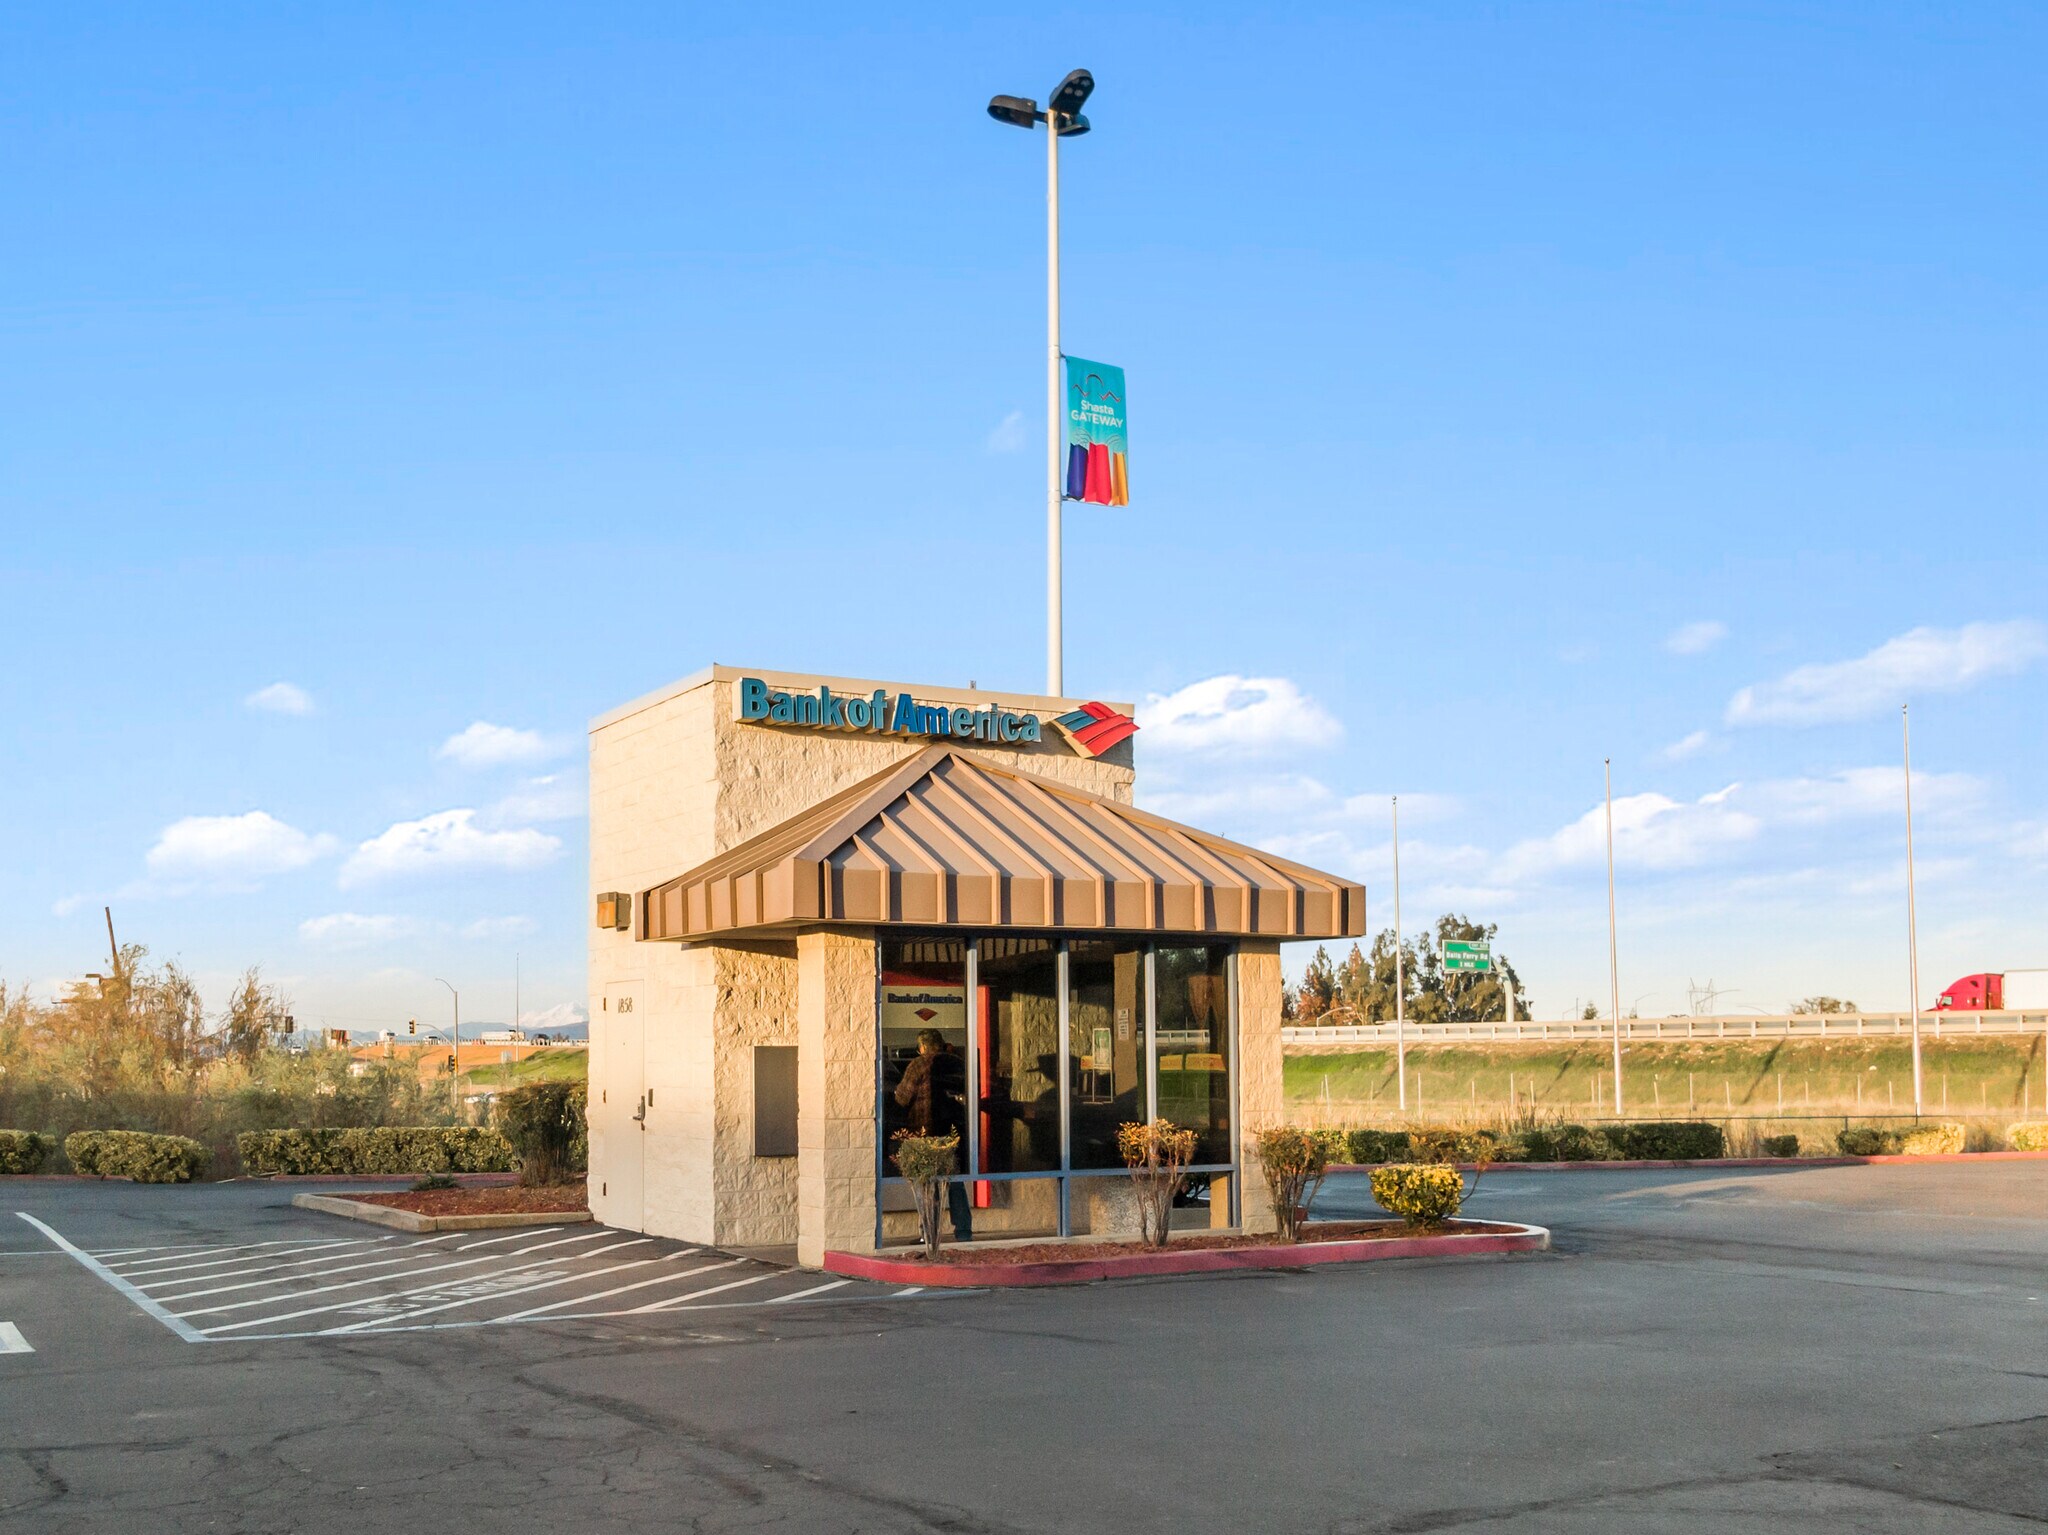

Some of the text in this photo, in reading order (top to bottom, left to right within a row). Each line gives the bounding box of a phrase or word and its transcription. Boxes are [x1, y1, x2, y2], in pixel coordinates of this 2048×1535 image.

[1080, 400, 1115, 416] Shasta
[1071, 410, 1123, 428] GATEWAY
[740, 677, 1042, 743] Bank of America
[617, 997, 633, 1014] 1858
